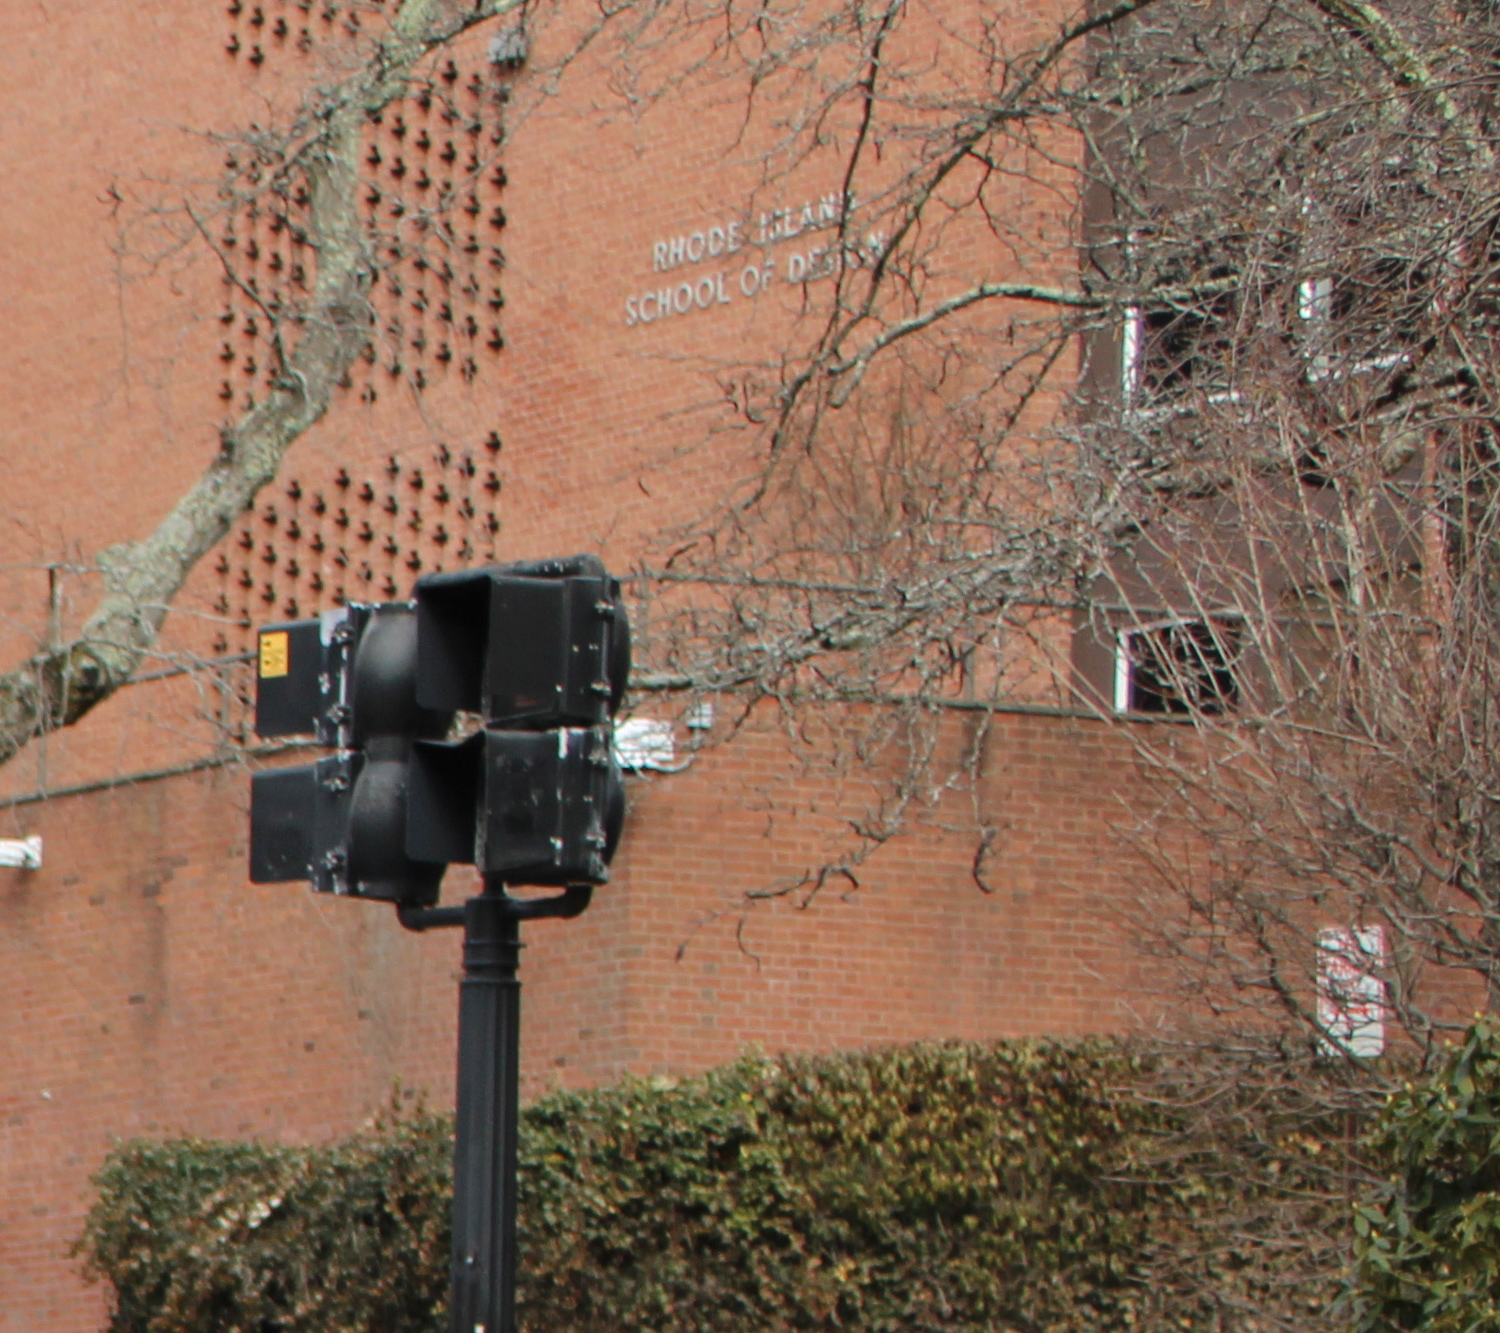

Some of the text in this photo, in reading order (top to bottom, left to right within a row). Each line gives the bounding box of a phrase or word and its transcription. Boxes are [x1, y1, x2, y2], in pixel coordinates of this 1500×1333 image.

[654, 222, 742, 271] RHODE
[625, 269, 731, 326] SCHOOL
[740, 258, 776, 296] OF
